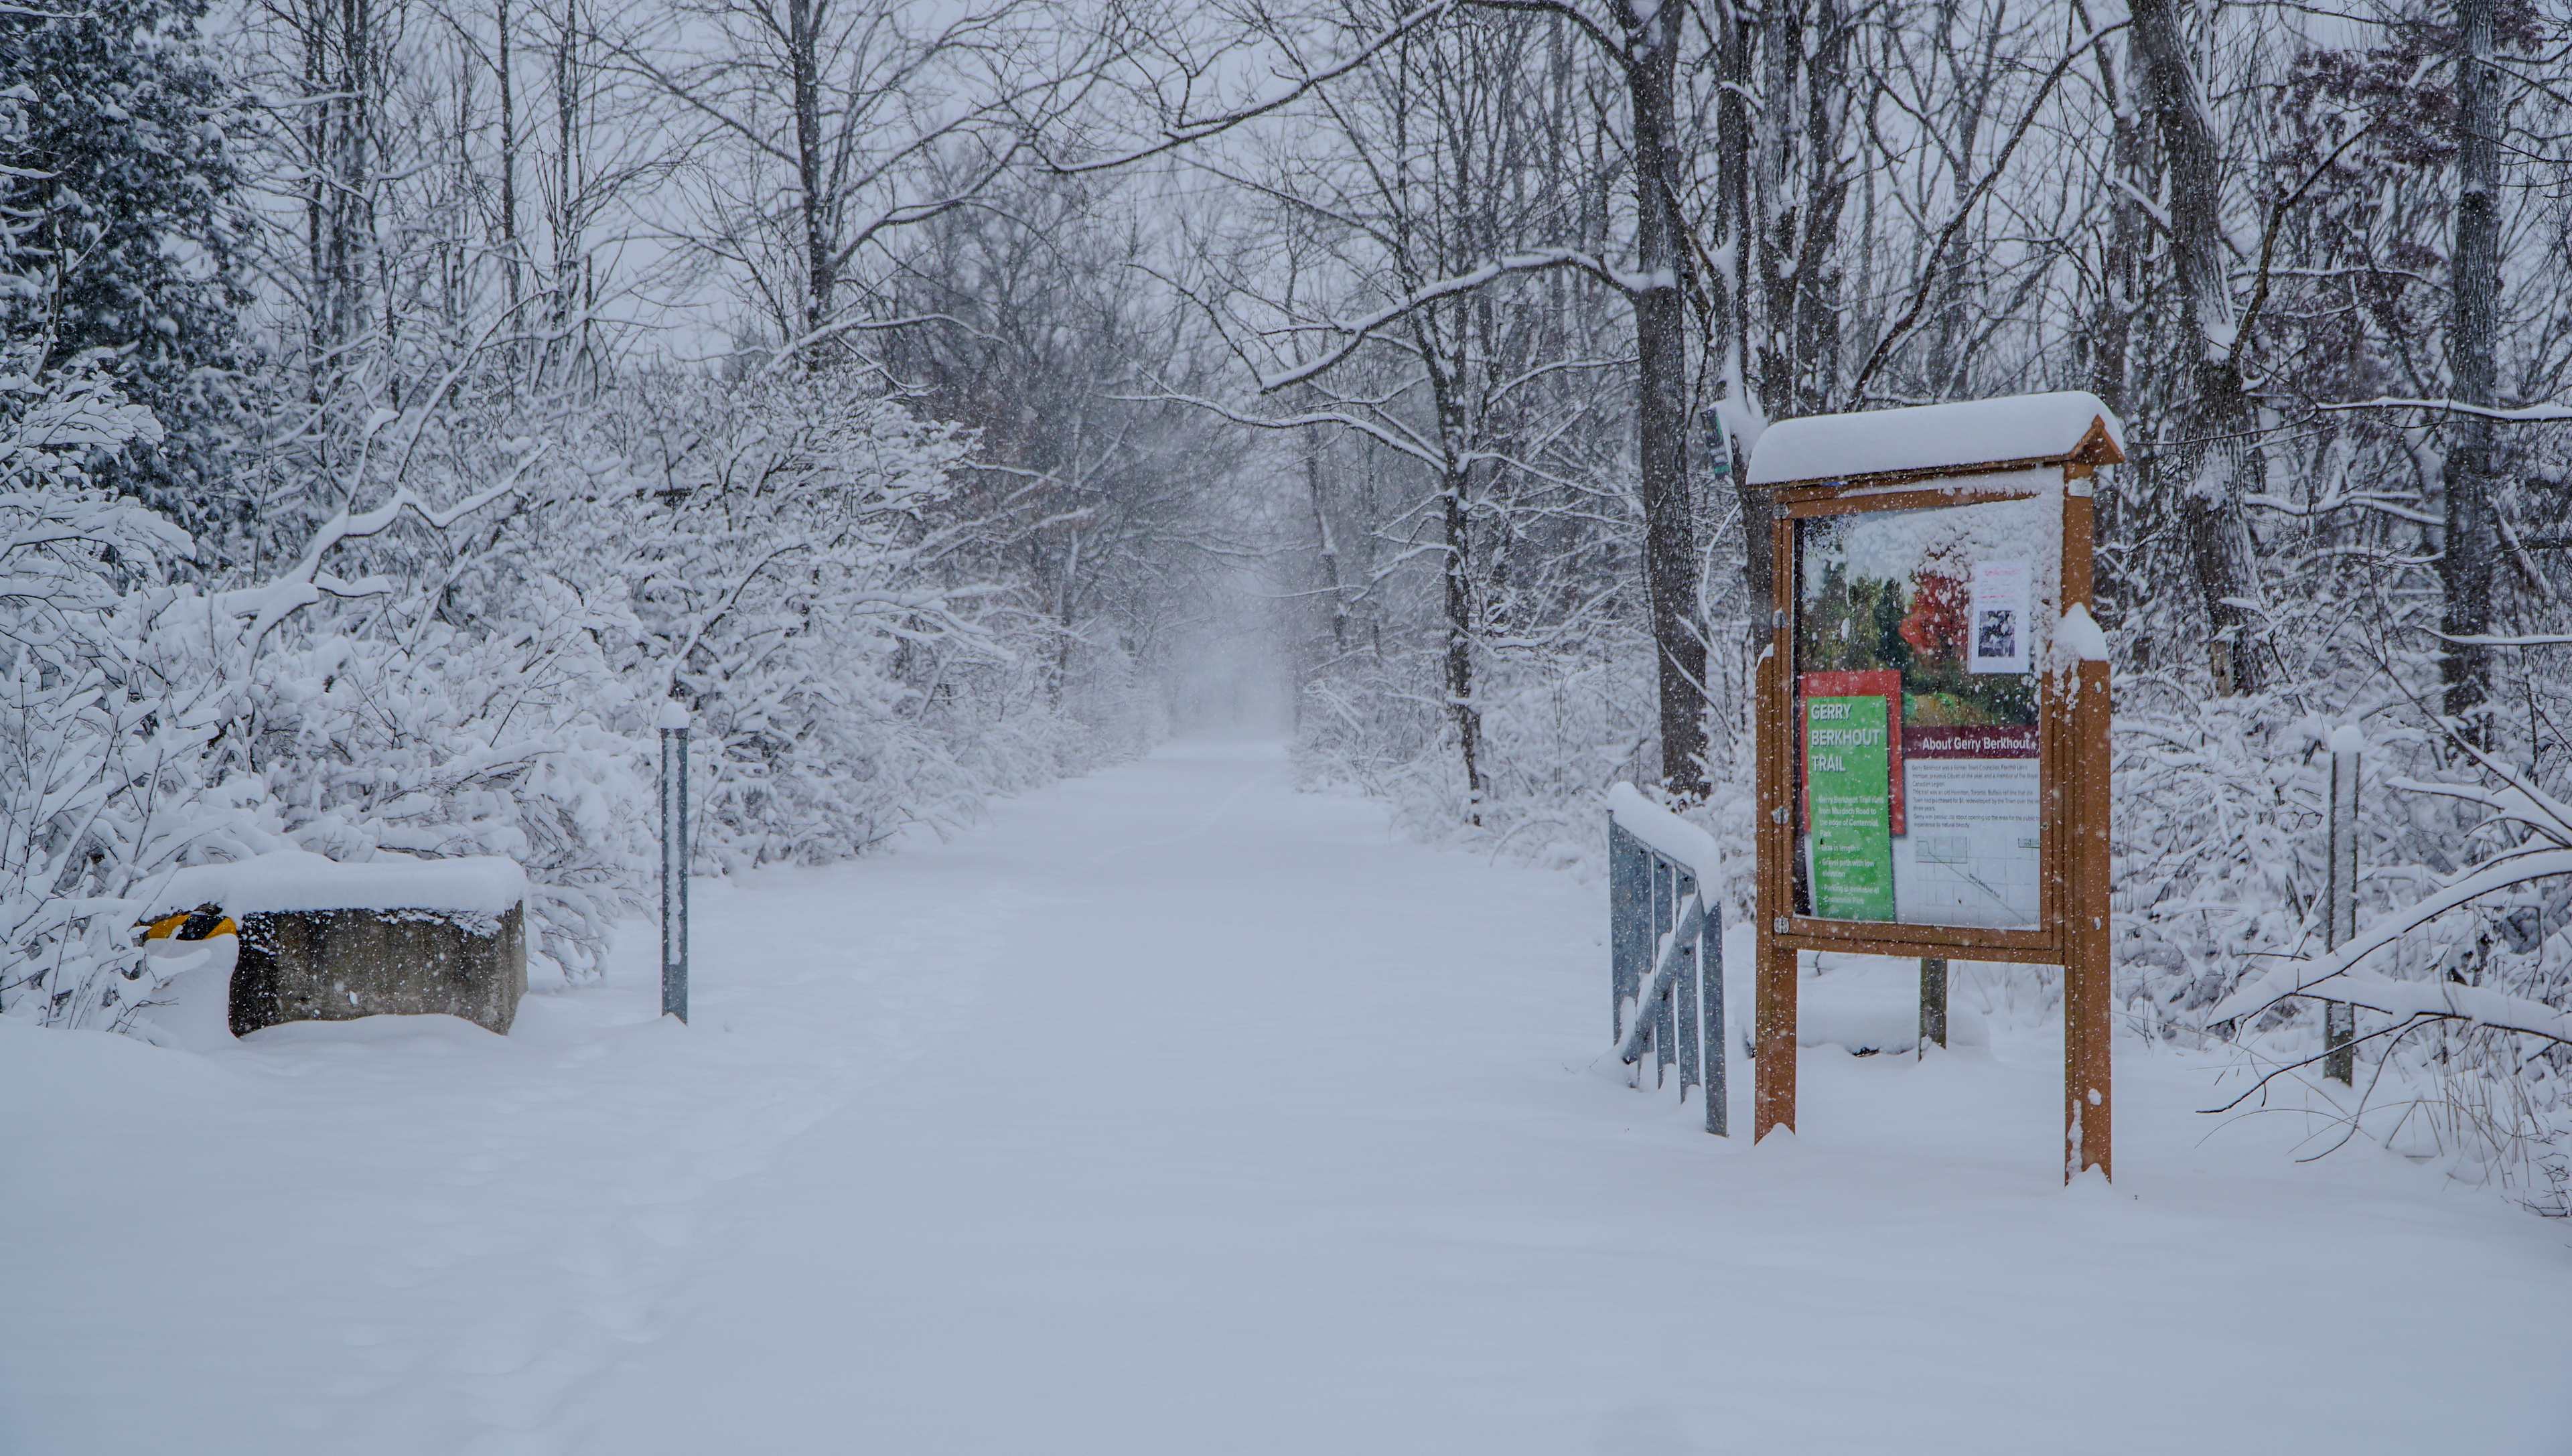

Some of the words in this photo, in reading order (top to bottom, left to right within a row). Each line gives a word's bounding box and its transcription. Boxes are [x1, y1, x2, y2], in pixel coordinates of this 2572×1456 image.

[1810, 703, 1852, 721] GERRY
[1811, 729, 1881, 746] BERKHOUT
[1922, 737, 1952, 751] About
[1954, 737, 1981, 752] Gerry
[1983, 737, 2030, 751] Berkhout
[1811, 755, 1846, 772] TRAIL
